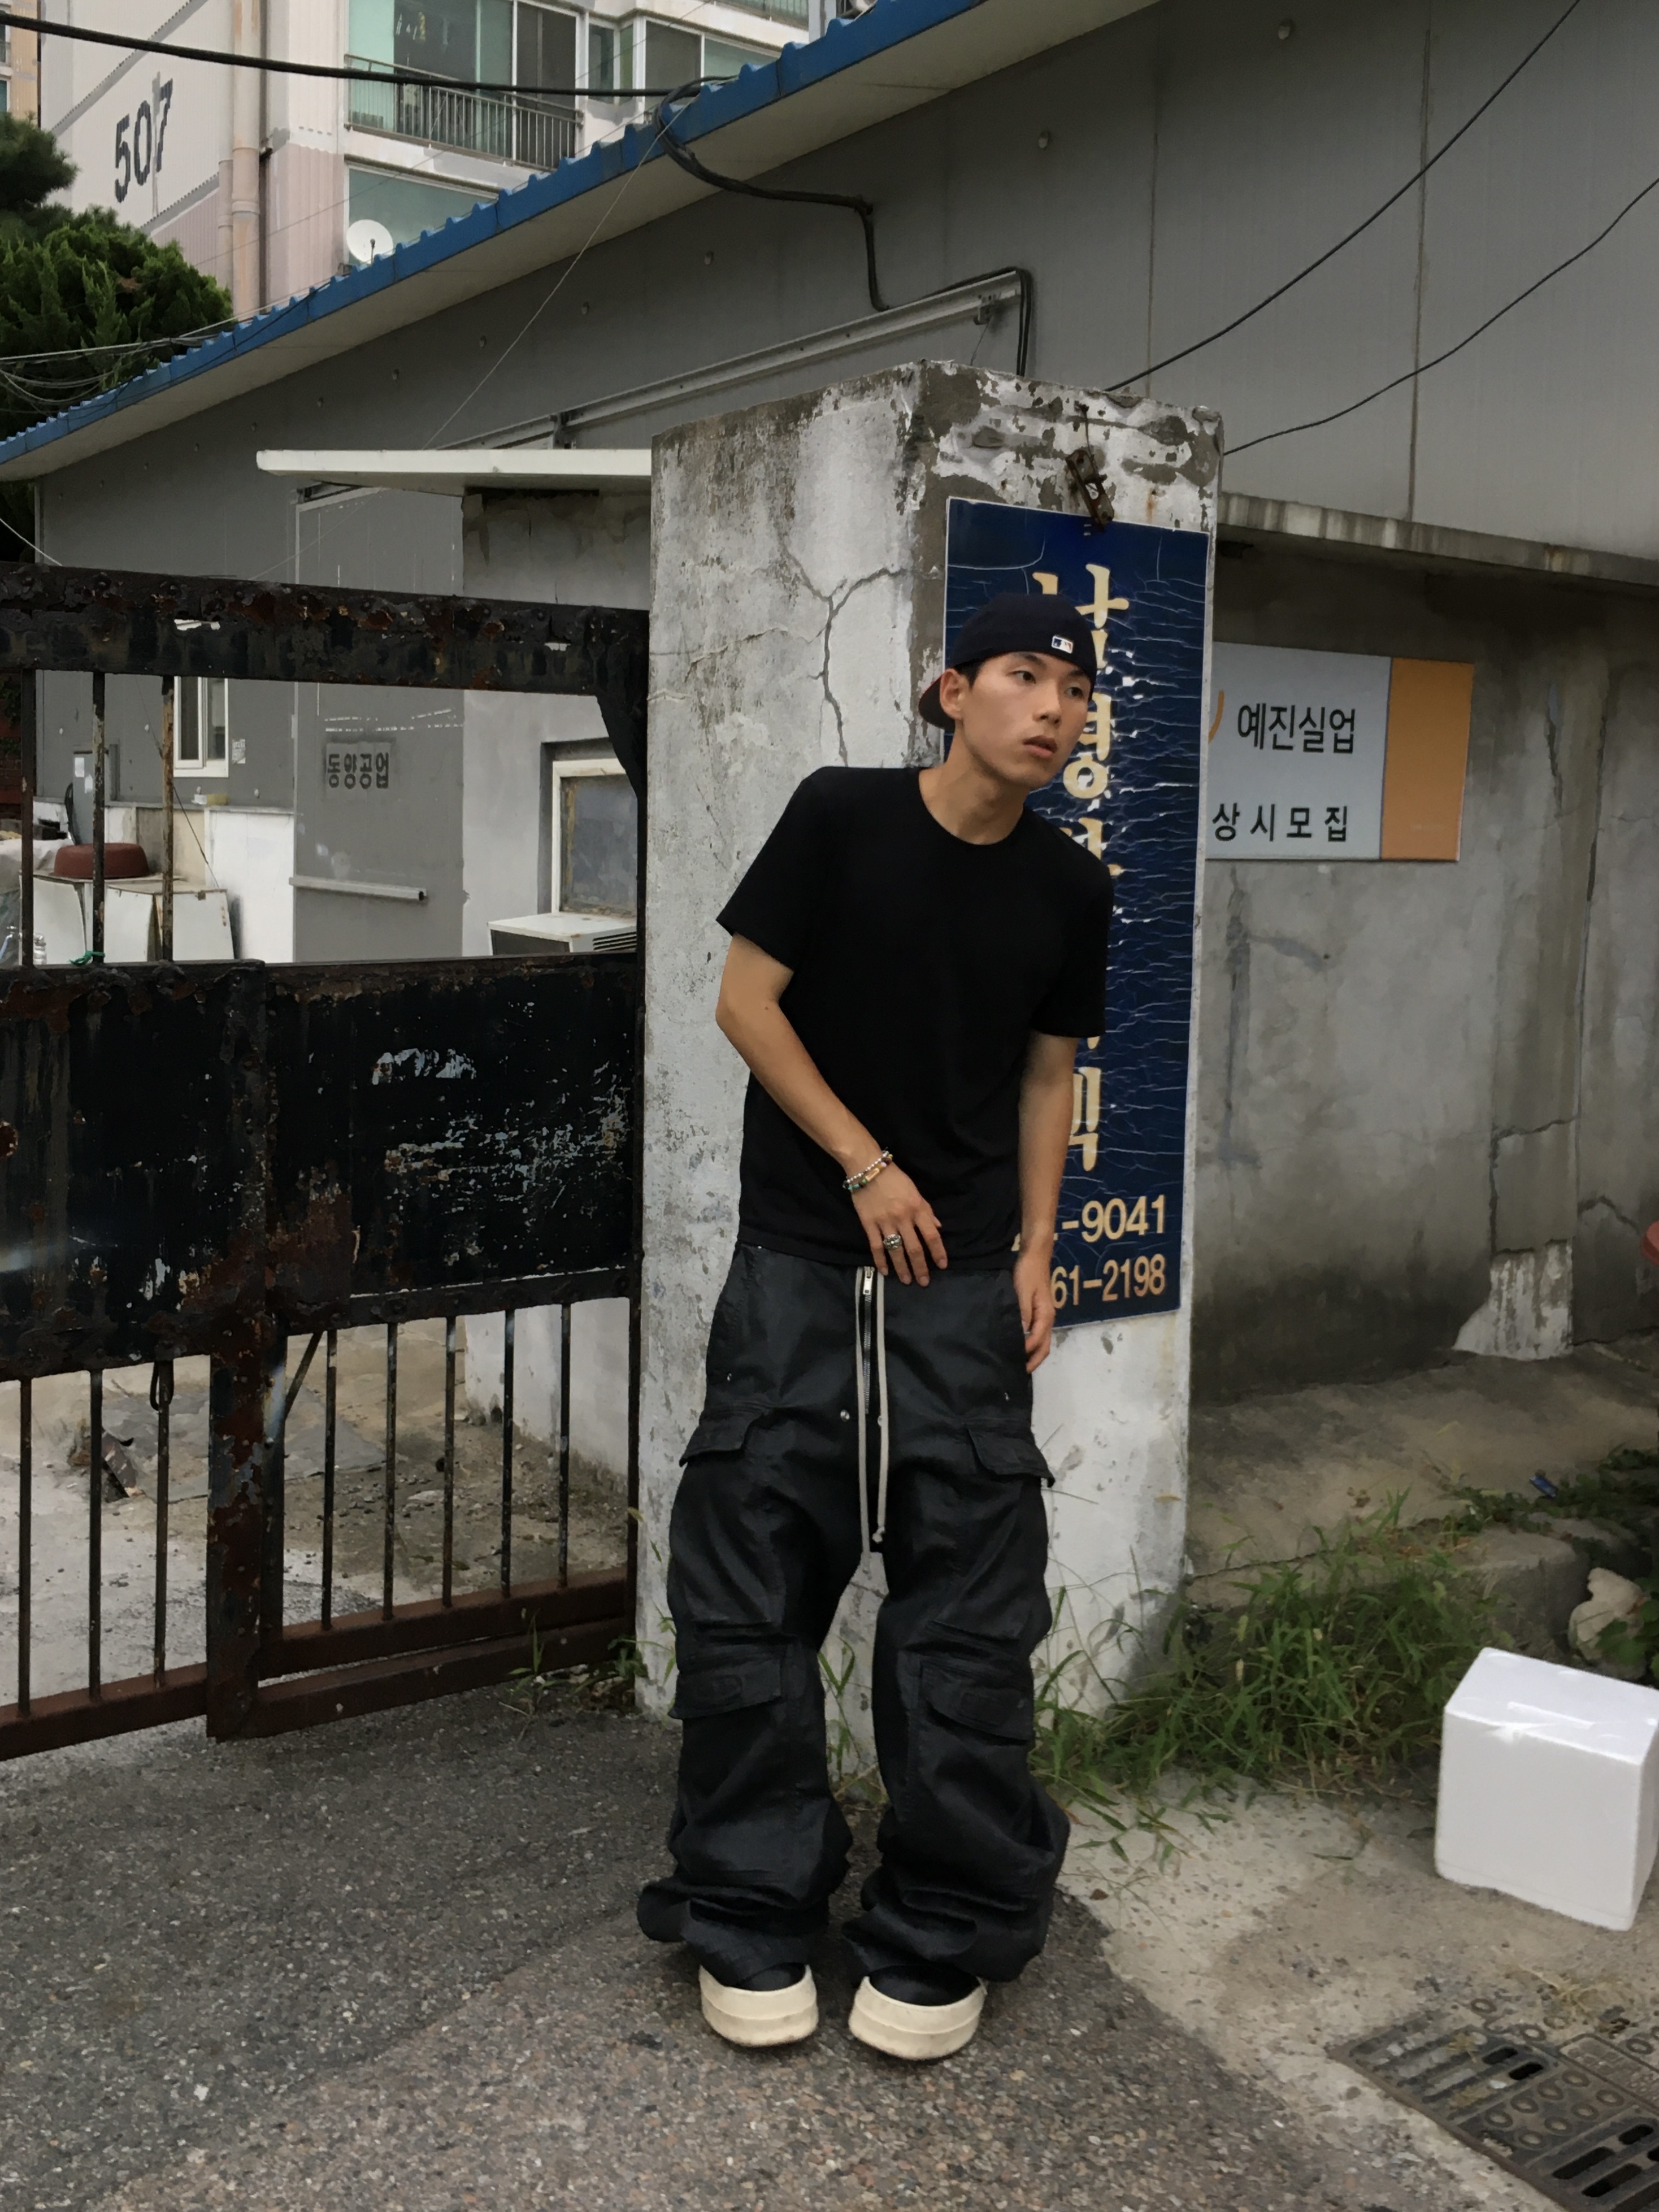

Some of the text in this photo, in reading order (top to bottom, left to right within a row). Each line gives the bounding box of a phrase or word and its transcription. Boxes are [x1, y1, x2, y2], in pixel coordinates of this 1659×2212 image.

[115, 77, 173, 204] 507
[1237, 702, 1356, 754] 예진실업
[1054, 1194, 1165, 1242] -9041
